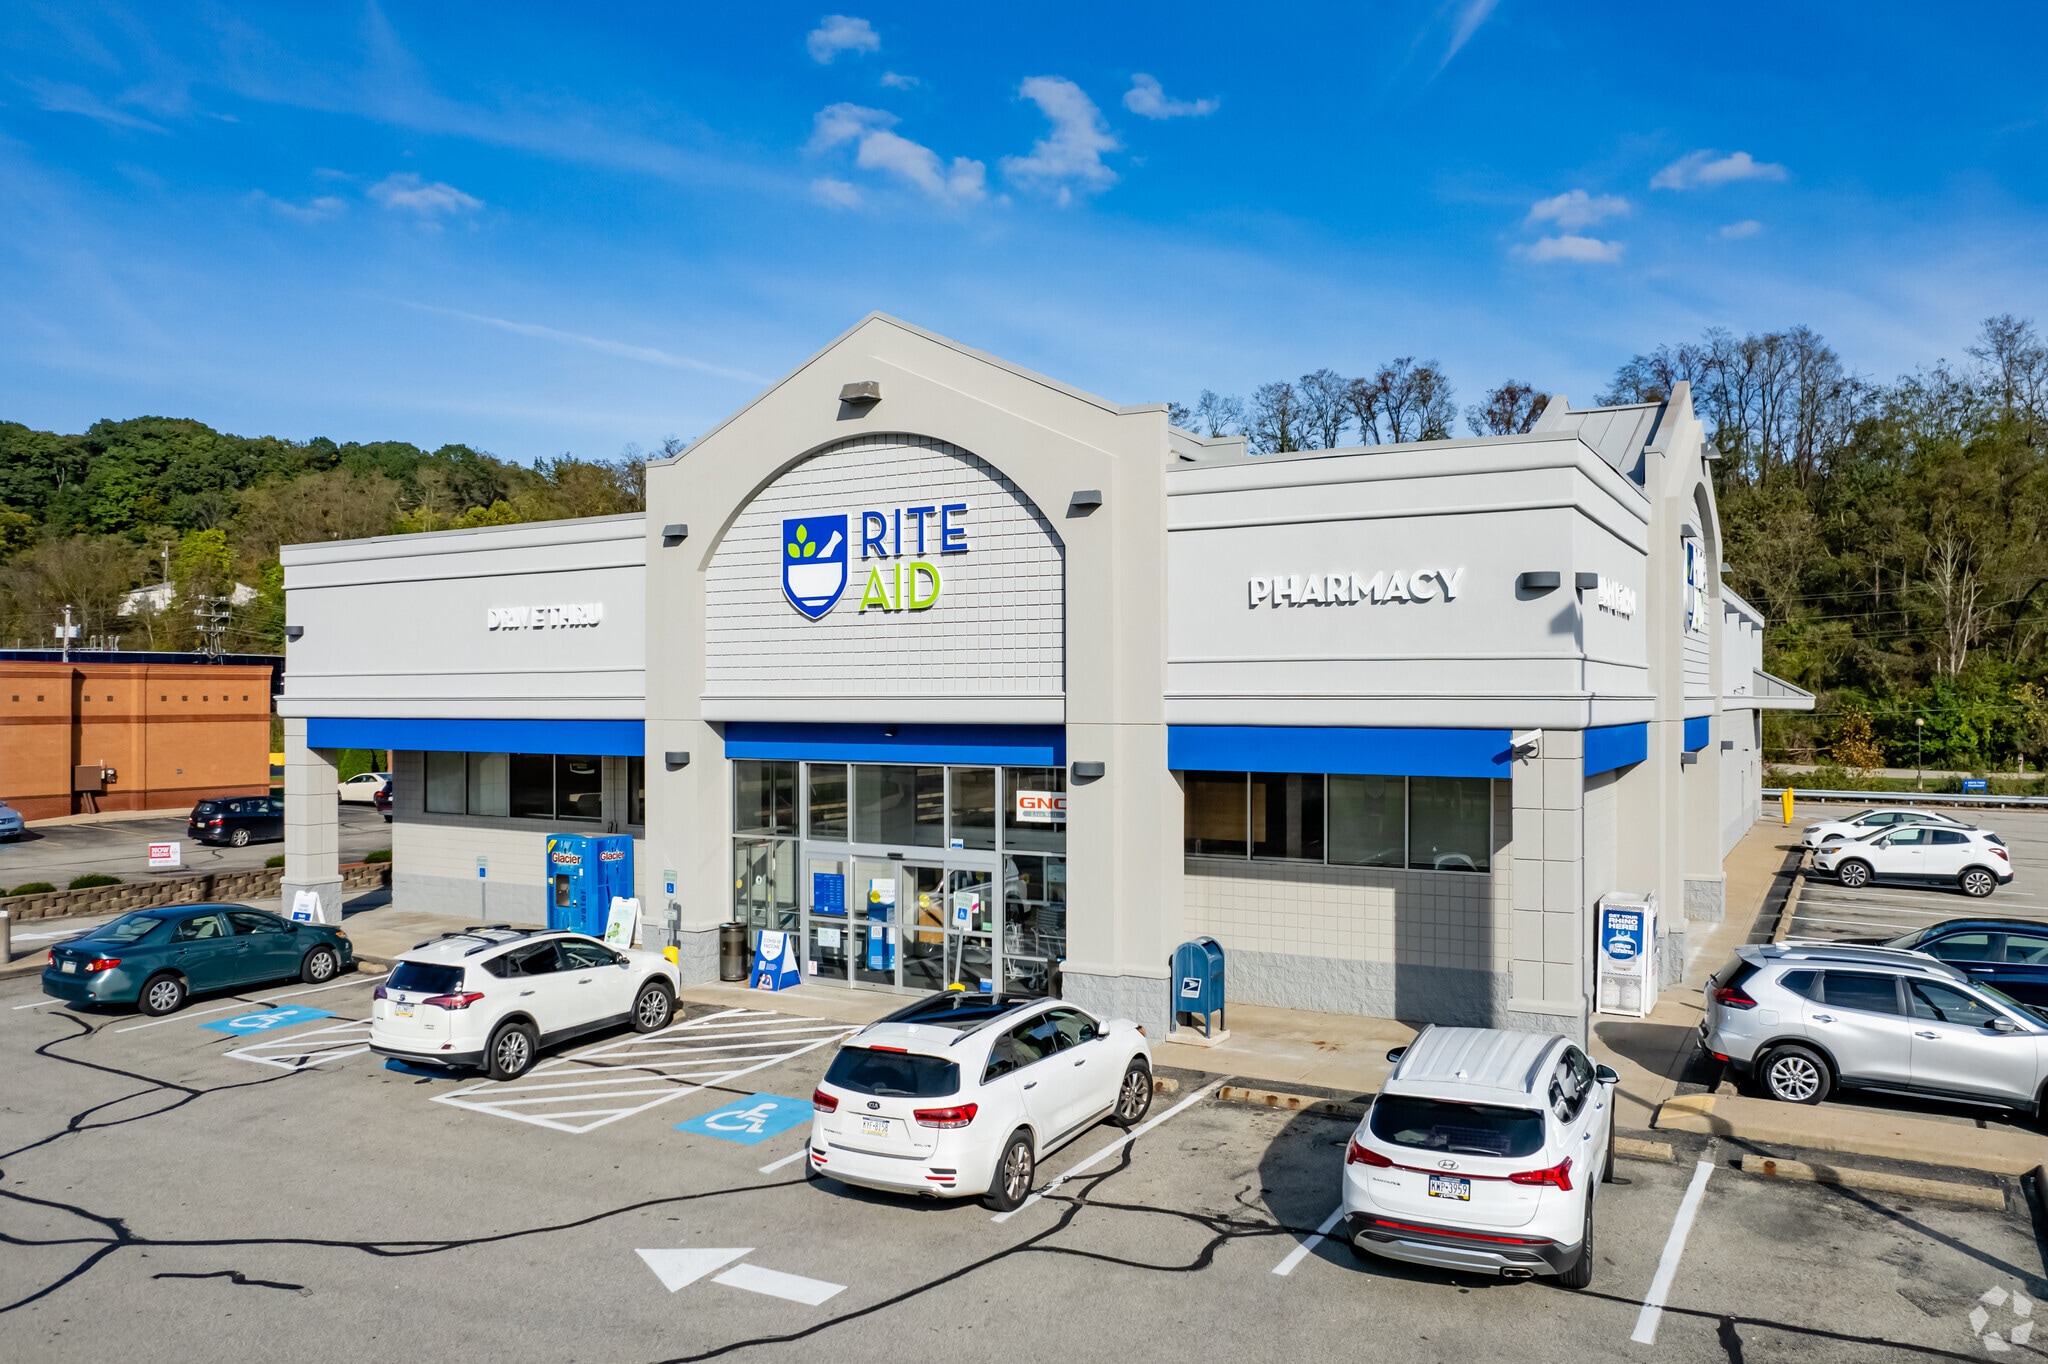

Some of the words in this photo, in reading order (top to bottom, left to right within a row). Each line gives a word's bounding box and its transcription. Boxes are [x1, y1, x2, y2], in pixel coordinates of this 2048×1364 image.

[861, 503, 968, 557] RITE
[859, 562, 941, 611] AID
[1249, 567, 1465, 607] PHARMACY
[487, 606, 545, 631] DRIVE
[546, 602, 603, 629] THRU
[1019, 797, 1066, 810] GNC
[552, 852, 581, 865] Glacier
[600, 851, 625, 862] Glacier
[1608, 917, 1639, 925] RHINO
[1608, 922, 1638, 931] HERE!
[868, 1101, 879, 1109] KIA
